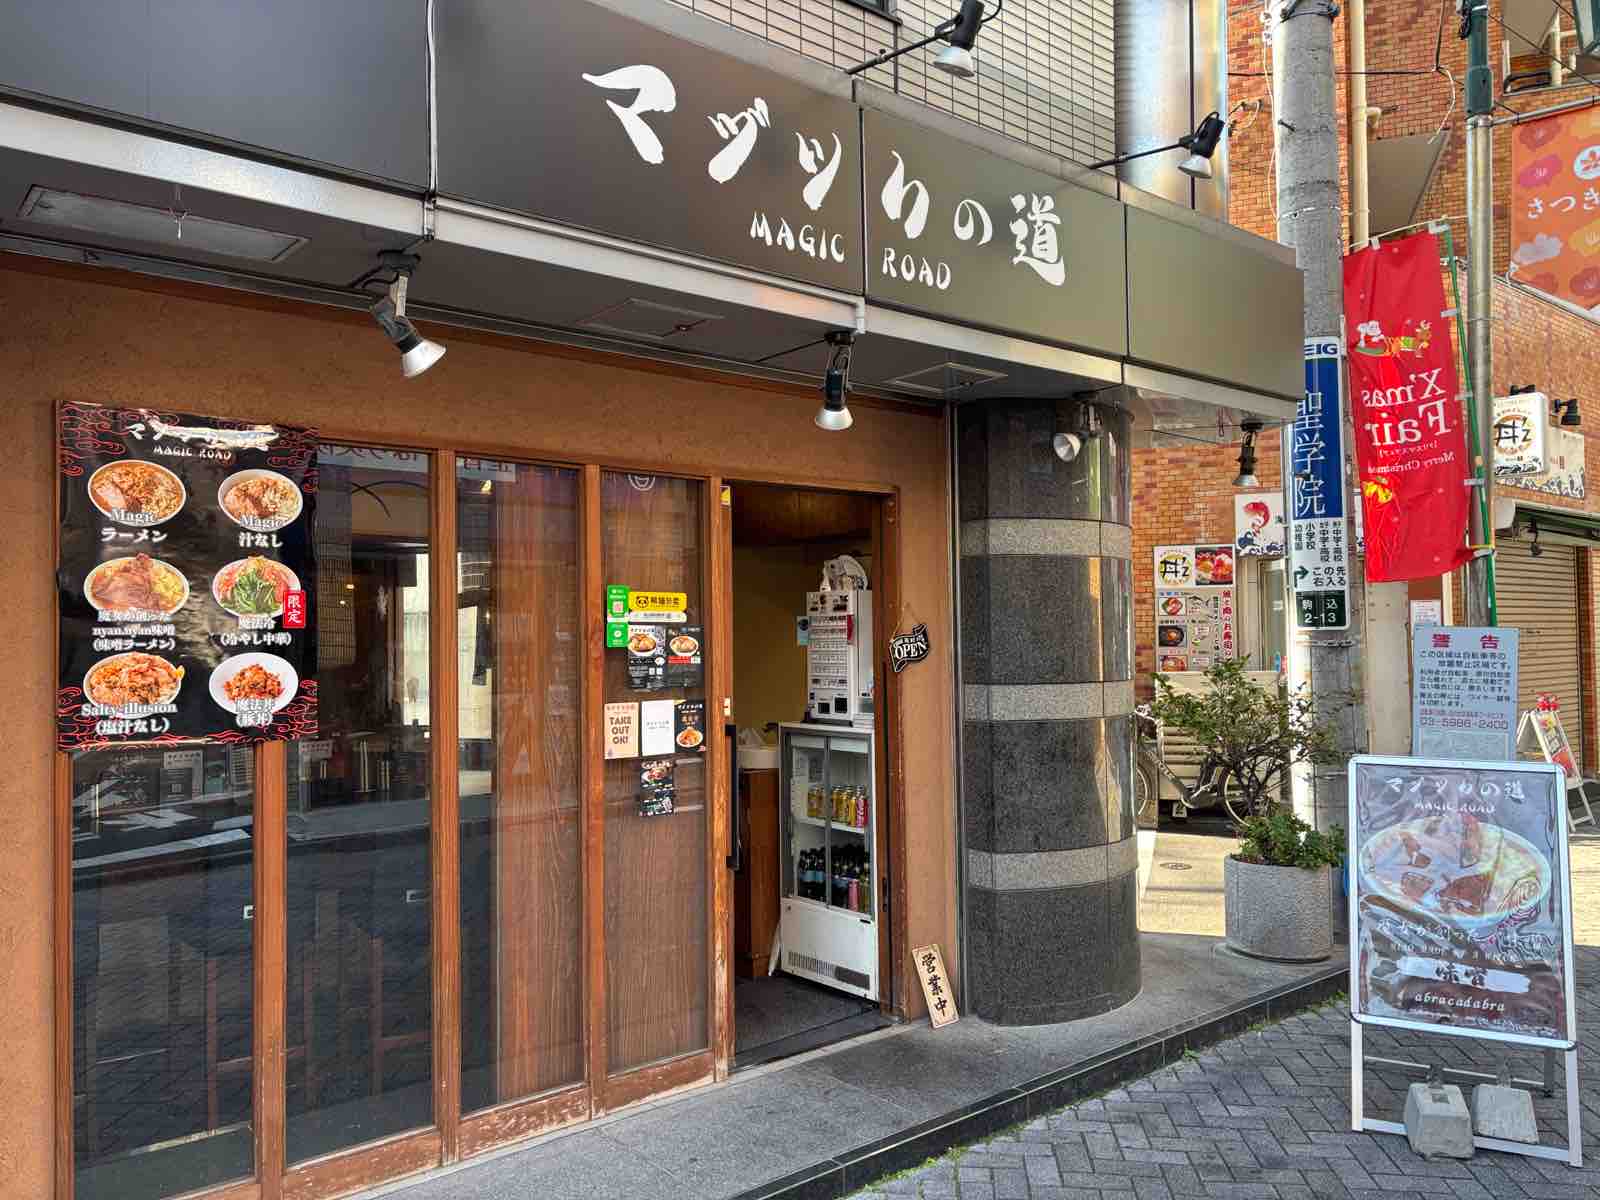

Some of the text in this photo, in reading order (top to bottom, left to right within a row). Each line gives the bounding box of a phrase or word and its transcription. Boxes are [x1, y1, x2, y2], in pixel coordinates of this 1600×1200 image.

[750, 211, 951, 290] MAGIC ROAD
[1295, 388, 1327, 517] 聖学院
[111, 508, 155, 526] Magic
[240, 514, 284, 531] Magic
[101, 527, 168, 544] ラーメン
[239, 531, 284, 548] 汁なし
[1305, 522, 1316, 550] 小学校
[1313, 566, 1345, 576] この先
[1313, 576, 1345, 587] 右入る
[287, 594, 302, 624] 限定
[1304, 612, 1337, 624] 2-13
[1432, 633, 1500, 649] 警告
[895, 641, 928, 660] OPEN
[609, 716, 632, 726] TAKE
[611, 726, 630, 735] OUT
[612, 736, 629, 745] OK!
[1414, 992, 1506, 1013] abracadabra
